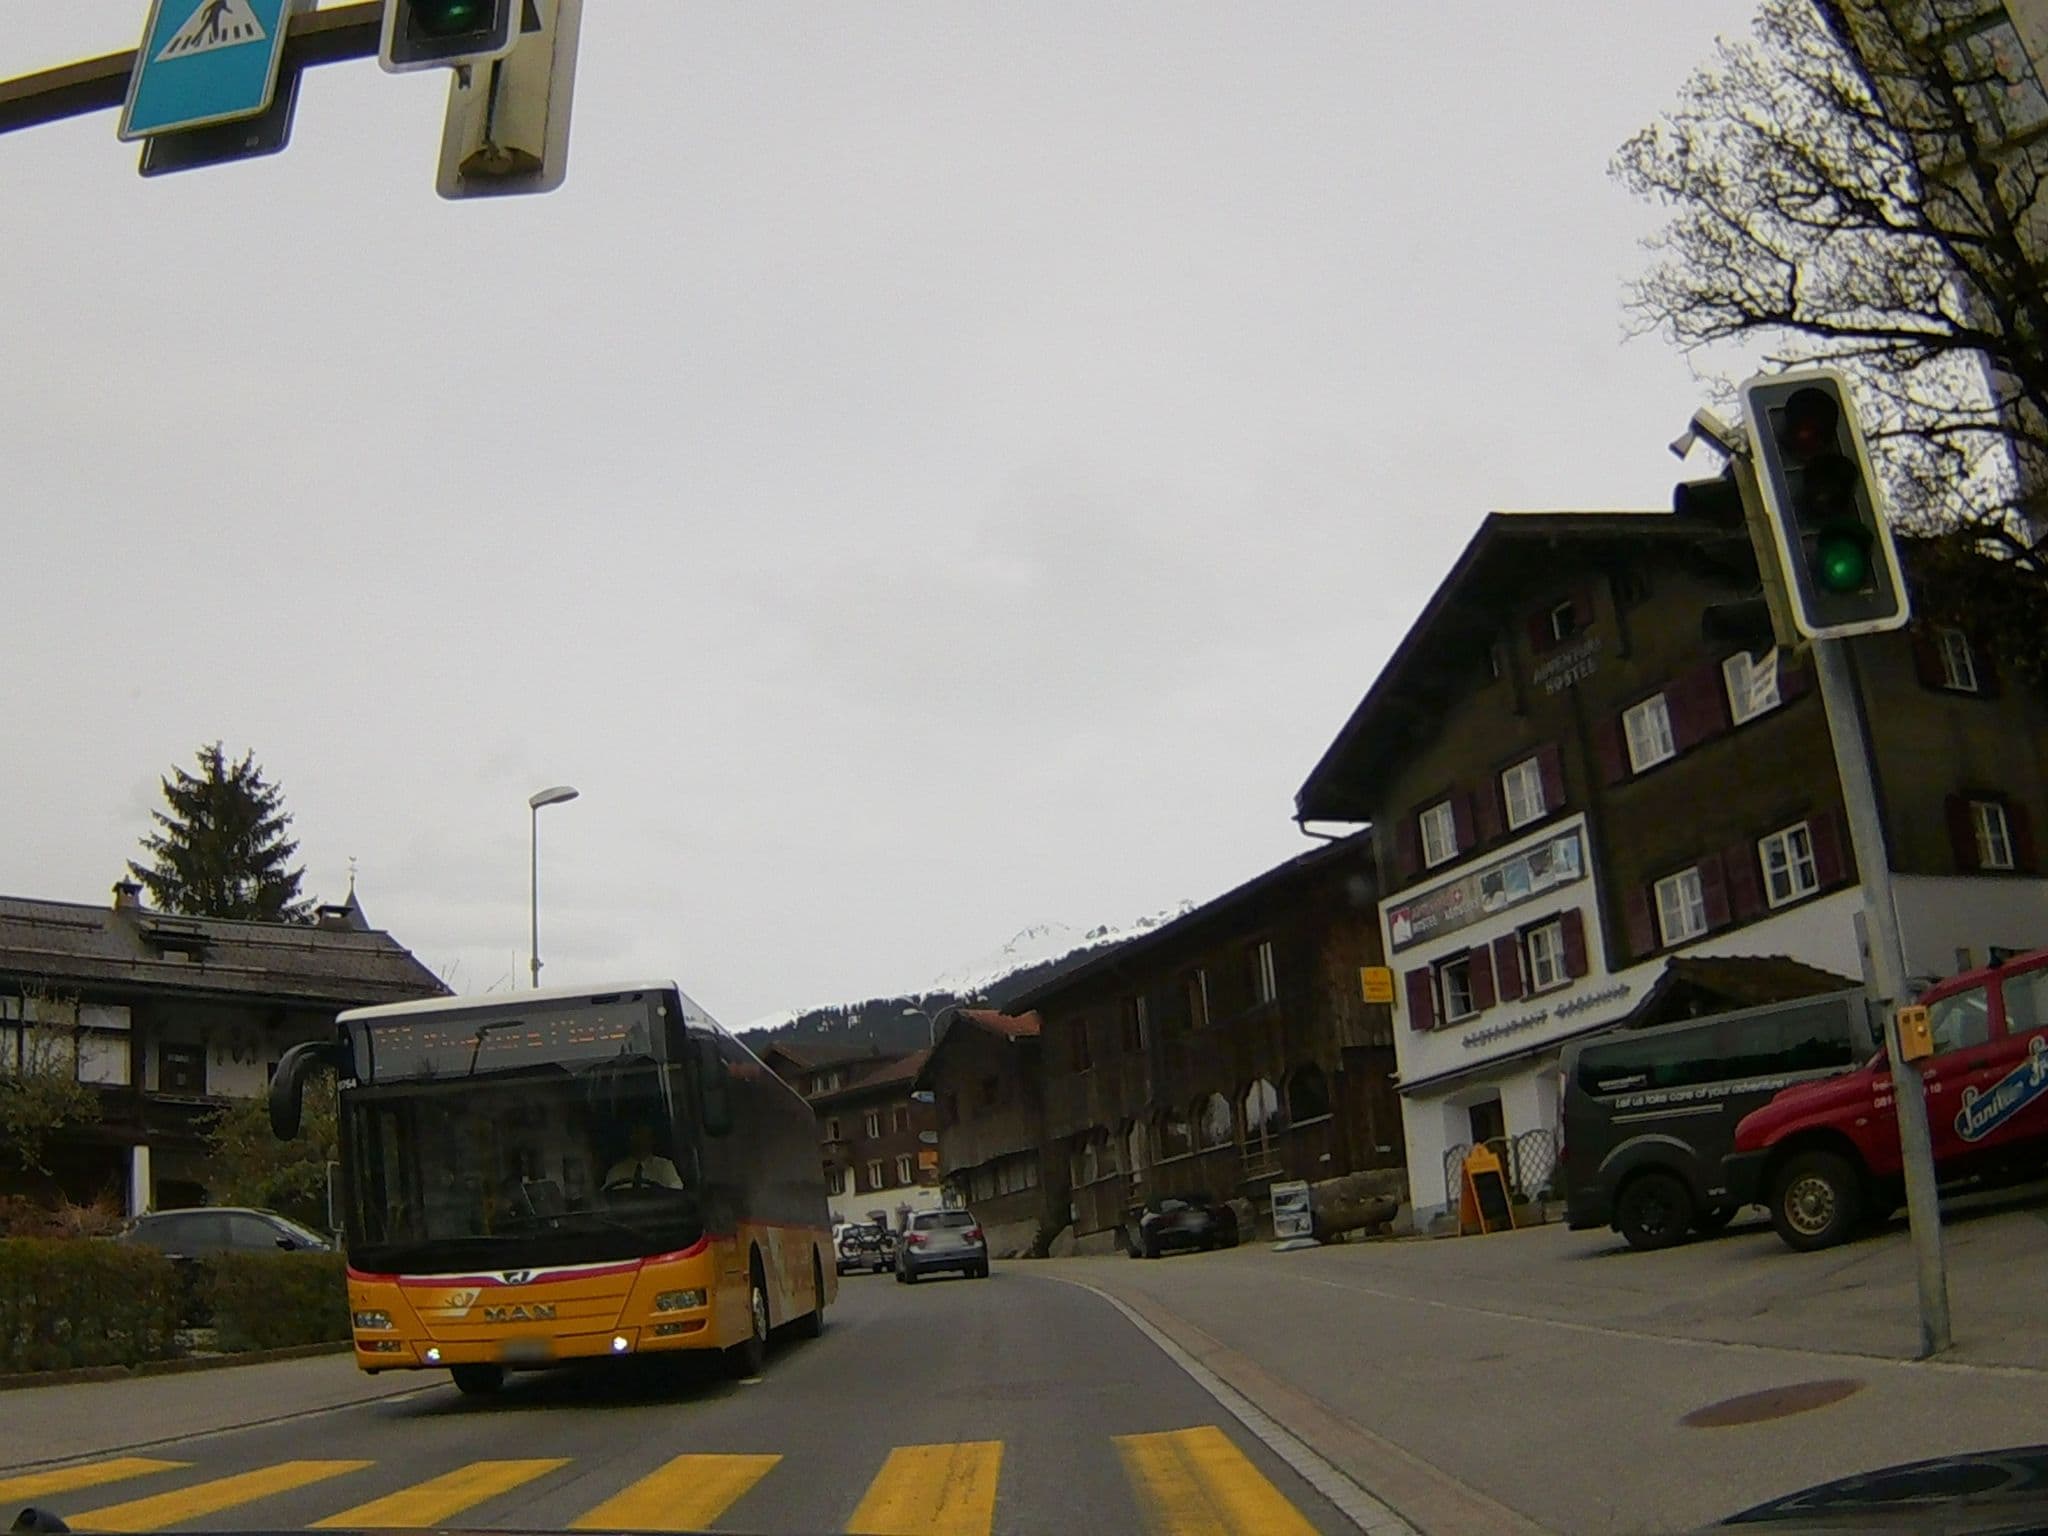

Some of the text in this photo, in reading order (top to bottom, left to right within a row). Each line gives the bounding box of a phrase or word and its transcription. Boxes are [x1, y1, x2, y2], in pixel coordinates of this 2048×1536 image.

[1615, 1097, 1631, 1109] Let
[1632, 1095, 1644, 1106] us
[1645, 1093, 1667, 1105] take
[1669, 1090, 1693, 1102] care
[1695, 1088, 1707, 1098] of
[1708, 1086, 1730, 1099] your
[483, 1303, 557, 1323] MAN
